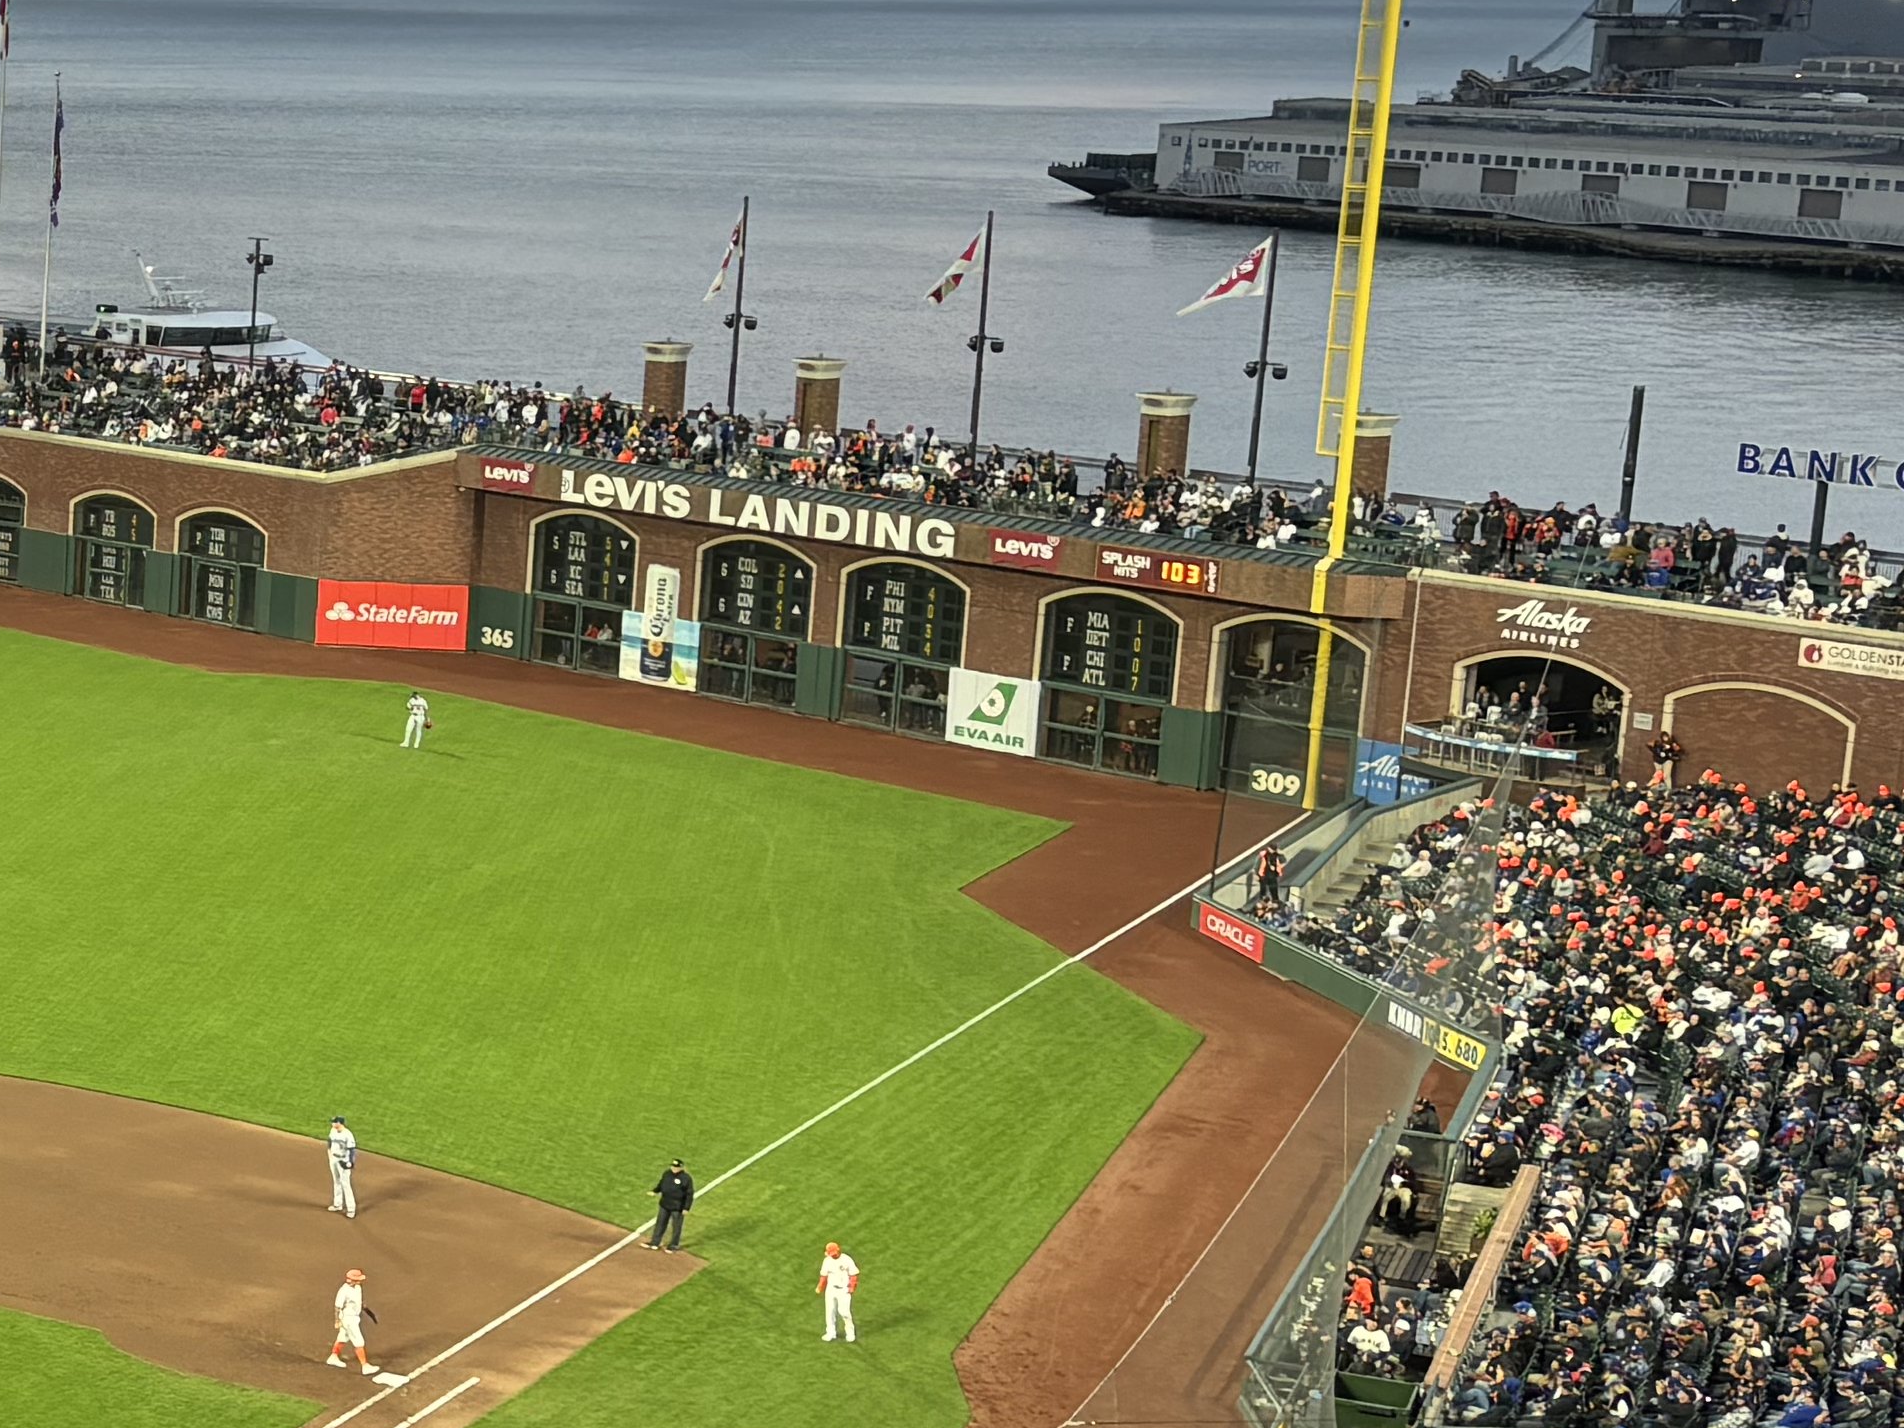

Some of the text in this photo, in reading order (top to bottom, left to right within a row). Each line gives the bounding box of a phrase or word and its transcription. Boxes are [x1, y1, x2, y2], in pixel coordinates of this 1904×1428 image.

[1737, 442, 1880, 487] BANK
[709, 488, 956, 559] LANDING
[568, 531, 587, 547] STL
[738, 557, 758, 574] COL
[1101, 551, 1151, 569] SPLASH
[1161, 561, 1201, 584] 103
[1113, 565, 1139, 578] HITS
[885, 580, 905, 597] PHI
[650, 577, 668, 638] Corona
[1496, 599, 1592, 634] Alaska
[1087, 611, 1110, 630] MIA
[480, 627, 514, 649] 365
[1500, 628, 1581, 649] AIRLINES
[953, 725, 1025, 749] EVA AIR
[1252, 769, 1301, 796] 309
[1205, 914, 1256, 952] ORACLE
[1387, 1000, 1423, 1040] KNBR
